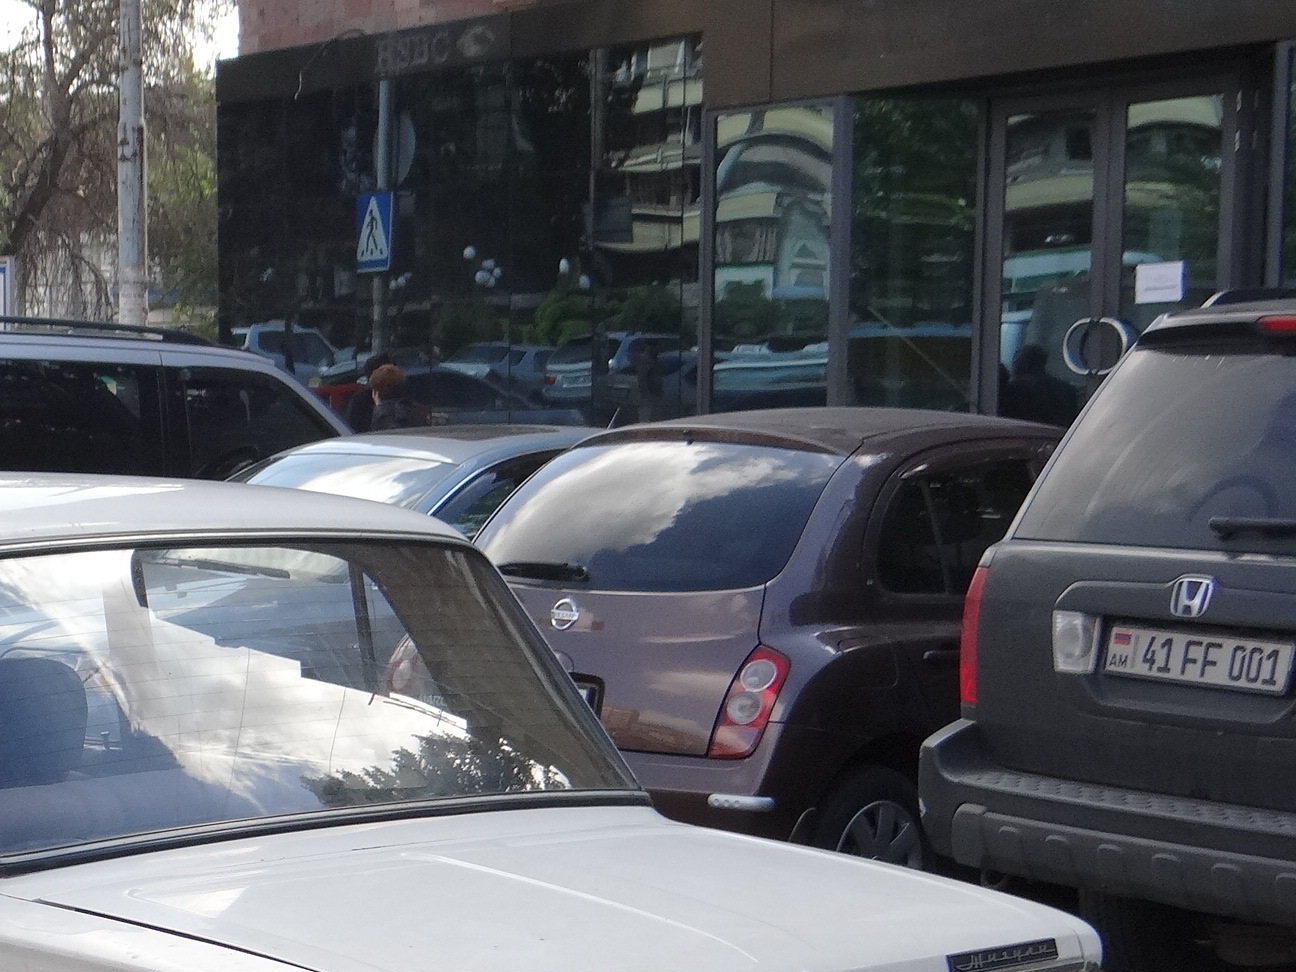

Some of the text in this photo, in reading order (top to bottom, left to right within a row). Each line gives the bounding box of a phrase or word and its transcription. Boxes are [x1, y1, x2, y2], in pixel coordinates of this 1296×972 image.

[1108, 636, 1282, 686] AM 41 FF 001
